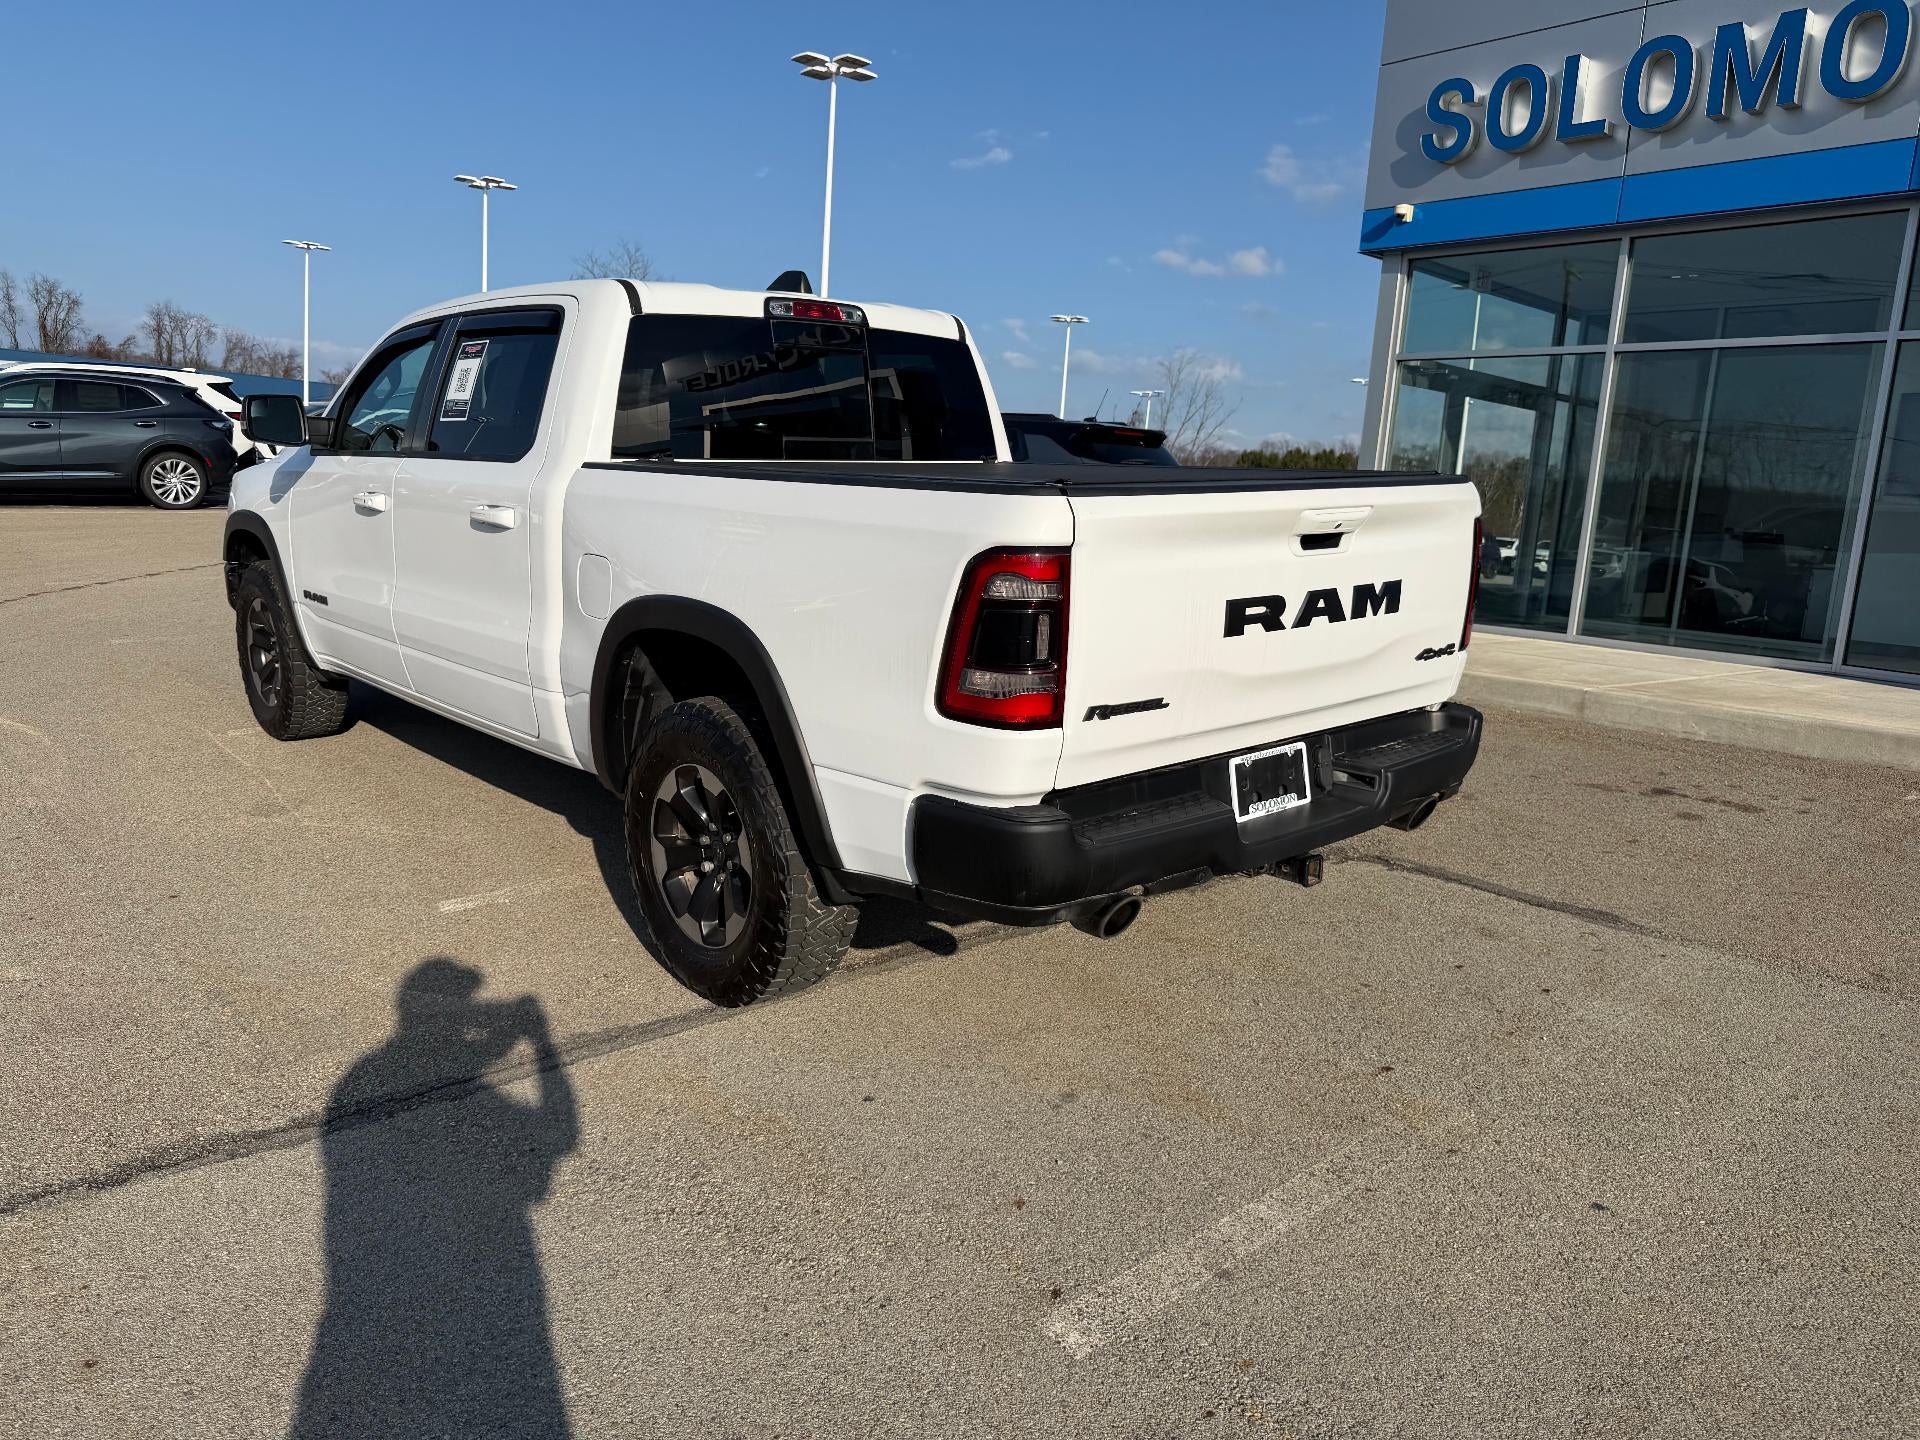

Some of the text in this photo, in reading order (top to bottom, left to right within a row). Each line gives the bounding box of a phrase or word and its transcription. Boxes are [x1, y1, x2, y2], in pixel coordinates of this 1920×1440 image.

[1420, 0, 1912, 163] SOLOMO
[1223, 579, 1402, 638] RAM
[1082, 697, 1170, 722] REBEL
[1250, 793, 1296, 814] SOLOMON
